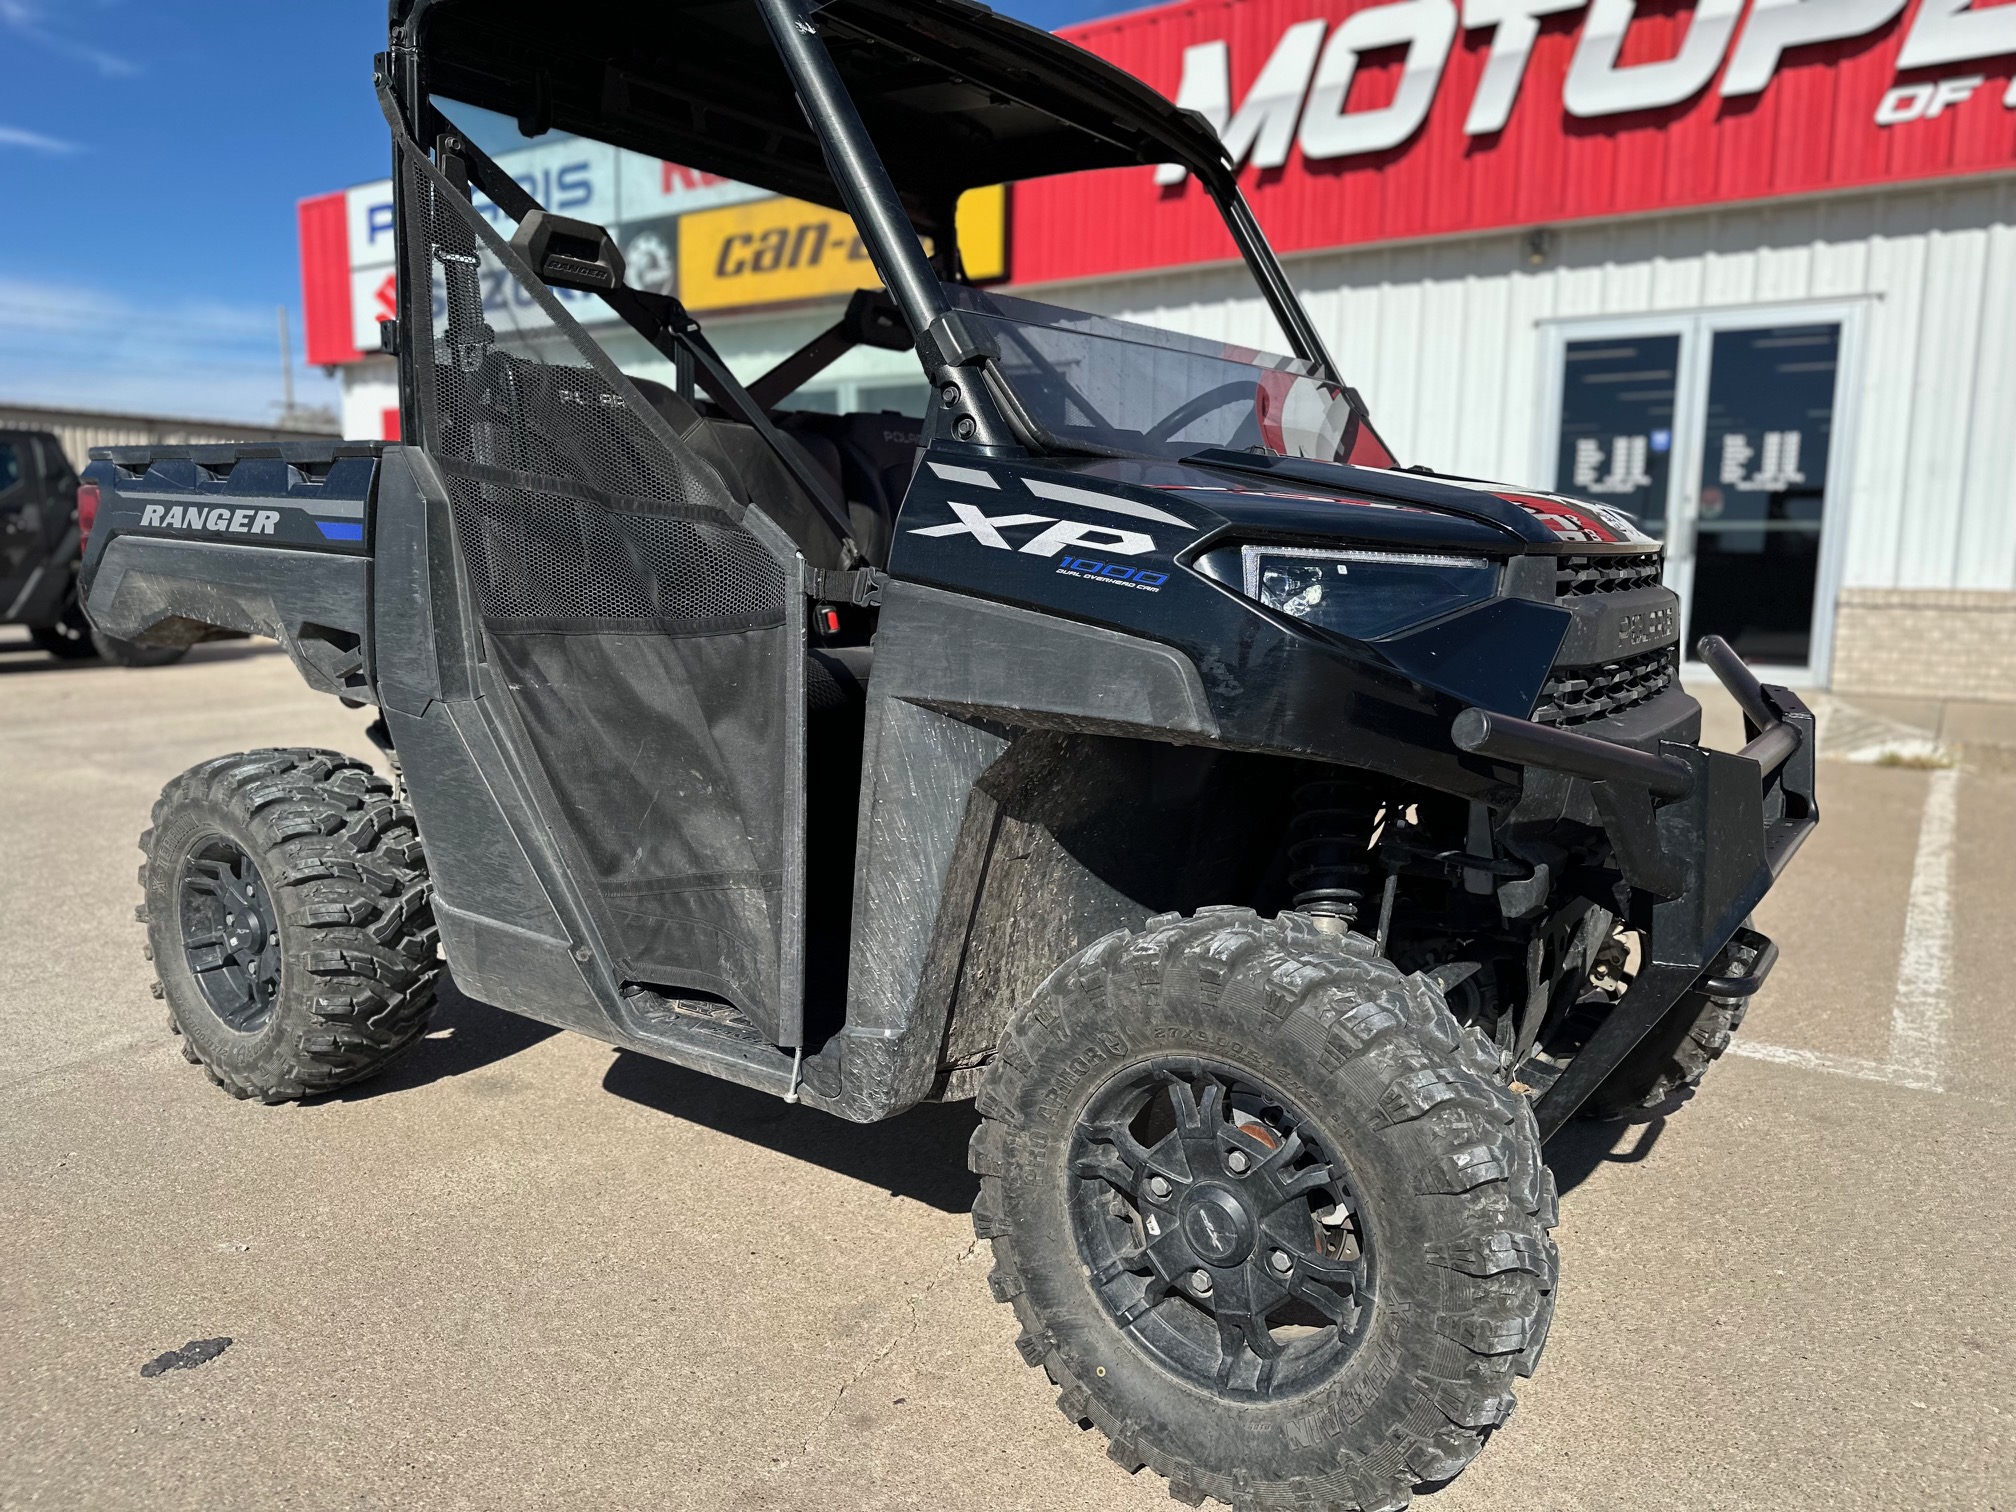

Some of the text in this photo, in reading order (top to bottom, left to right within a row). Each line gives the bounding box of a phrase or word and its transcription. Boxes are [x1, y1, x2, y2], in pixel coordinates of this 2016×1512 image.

[1873, 73, 1986, 127] OF
[549, 261, 608, 280] RANGER
[139, 504, 280, 535] RANGER
[906, 501, 1156, 557] XP
[1055, 568, 1160, 593] DUAL OVERHEAD CAM
[1060, 556, 1170, 586] 1000
[1023, 1046, 1107, 1187] PRO ARMOR
[1285, 1286, 1411, 1450] X-TERRAIN
